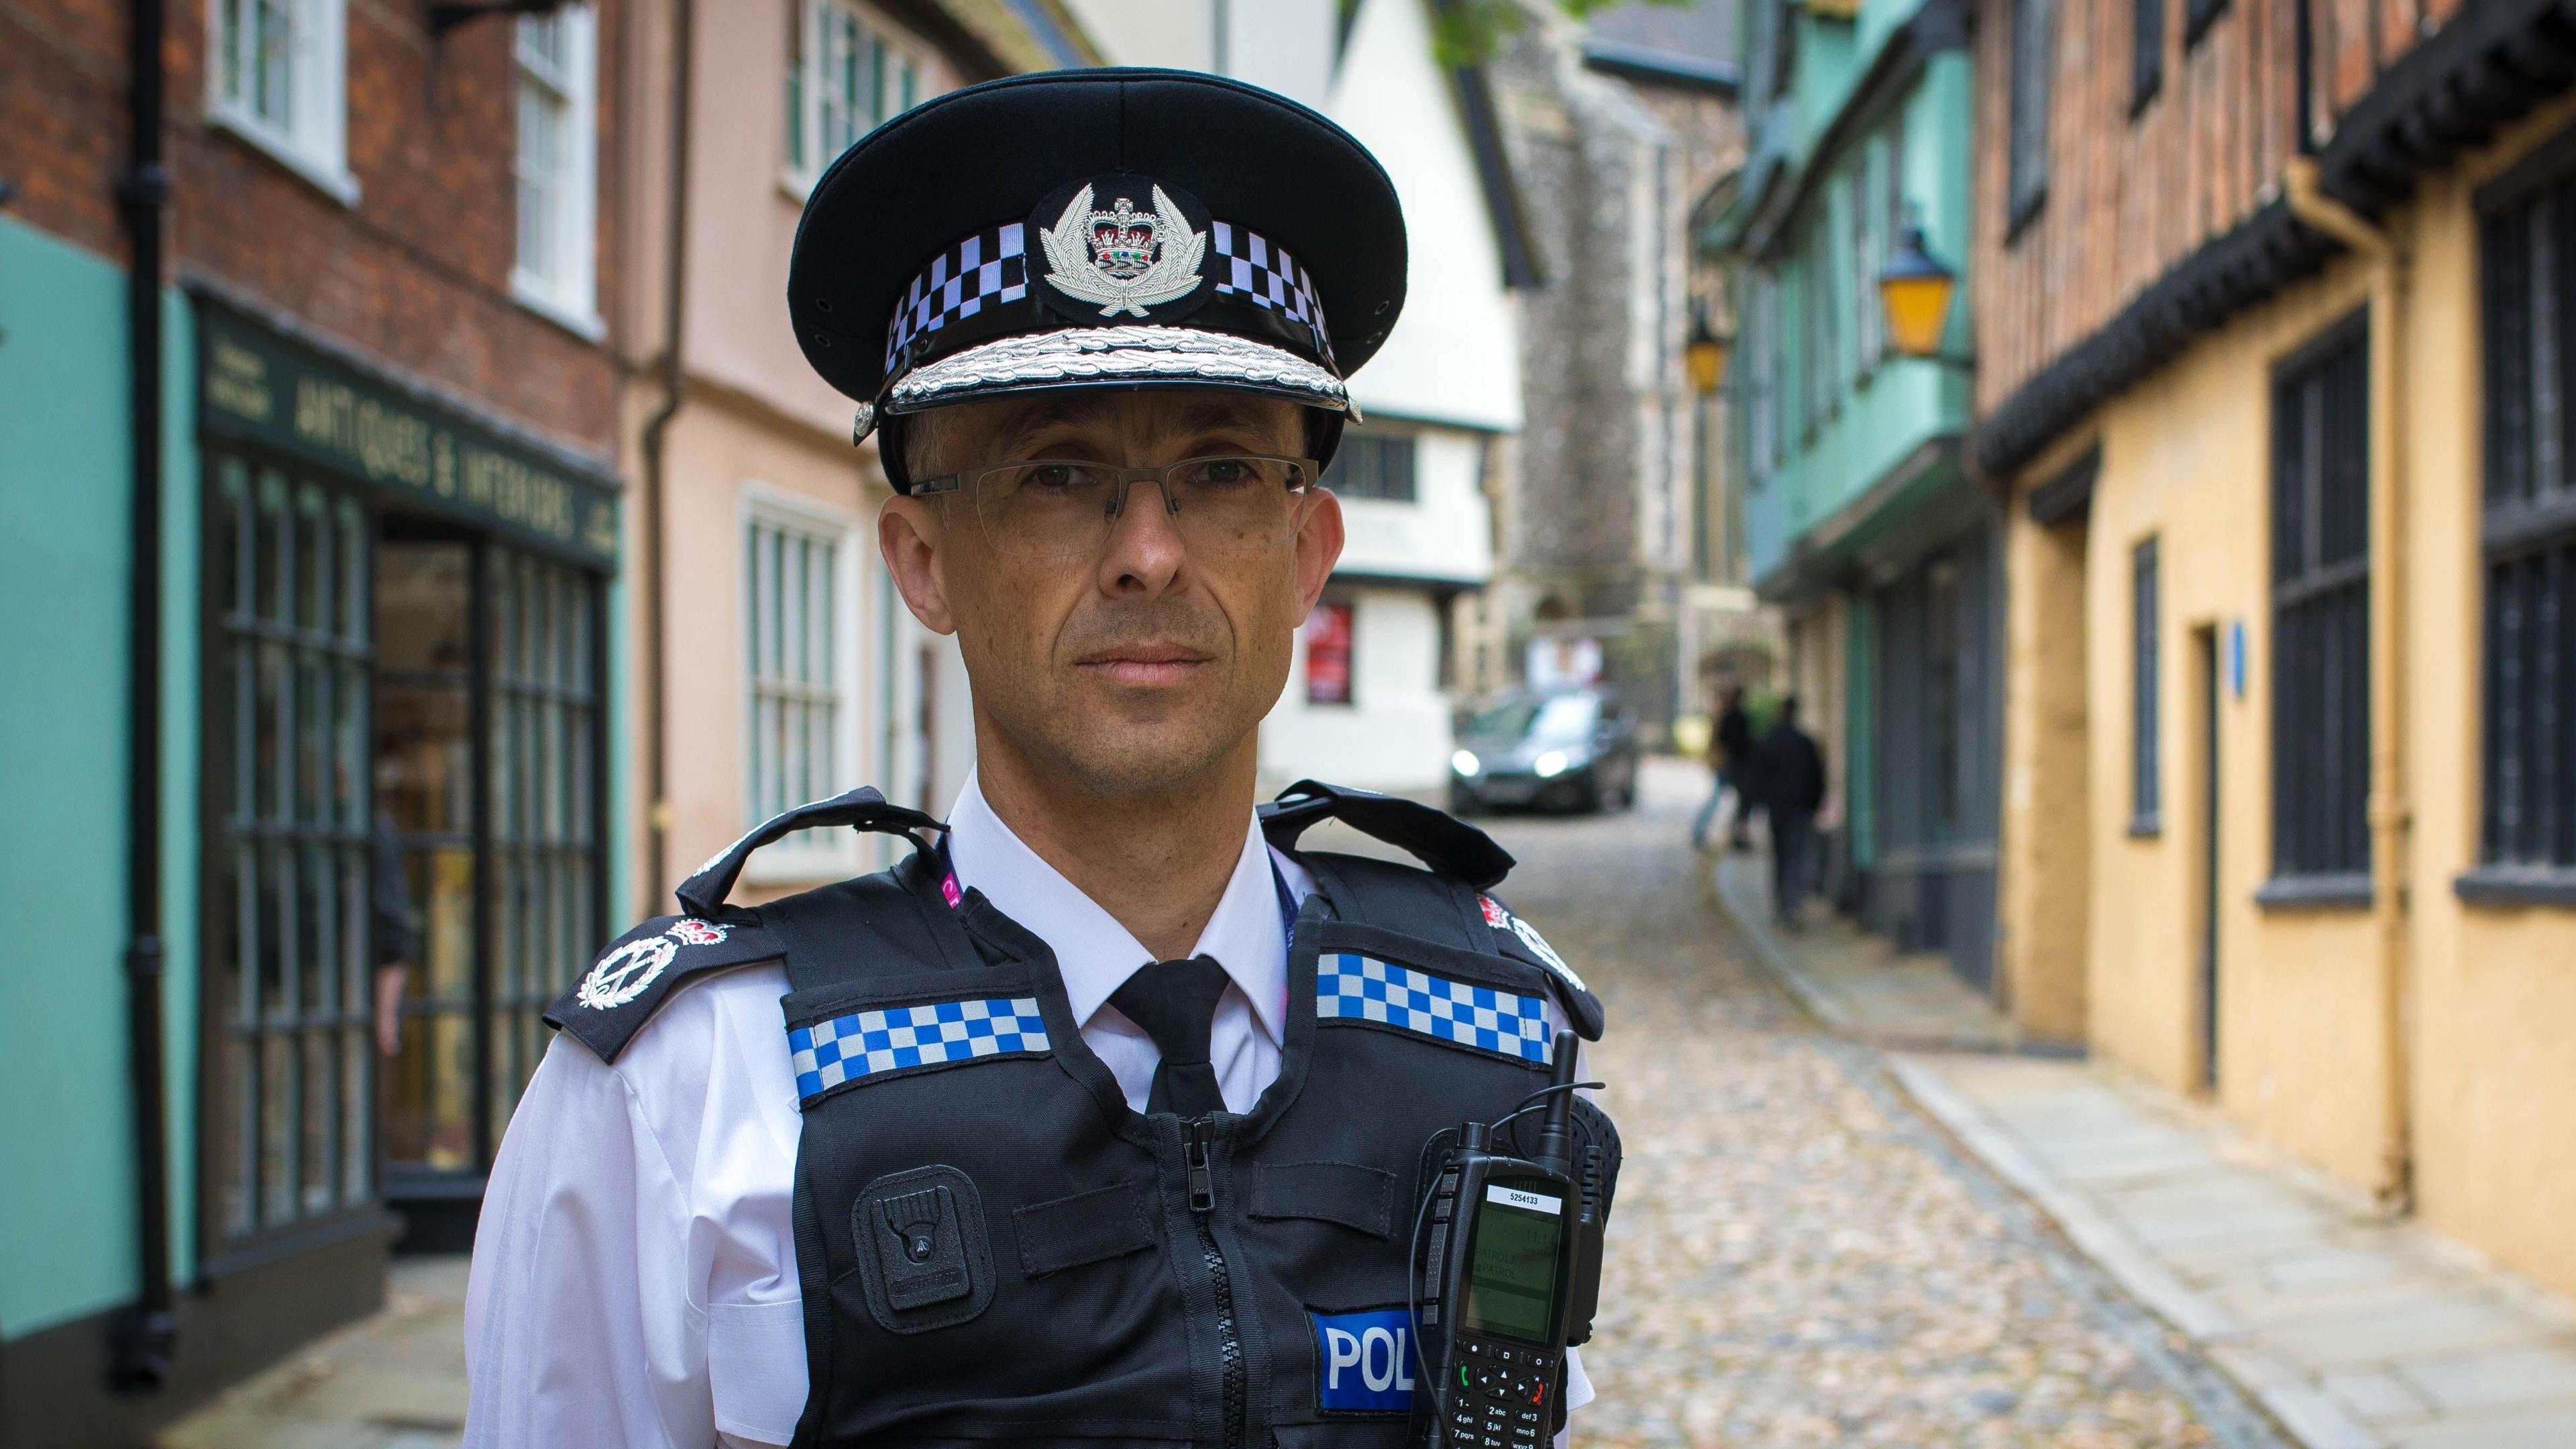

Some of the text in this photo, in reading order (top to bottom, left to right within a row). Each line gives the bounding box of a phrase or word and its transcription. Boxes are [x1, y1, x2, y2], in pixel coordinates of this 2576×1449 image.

[1510, 1193, 1538, 1205] 5254133
[1483, 1263, 1516, 1280] PATROL
[1326, 1326, 1415, 1392] POL
